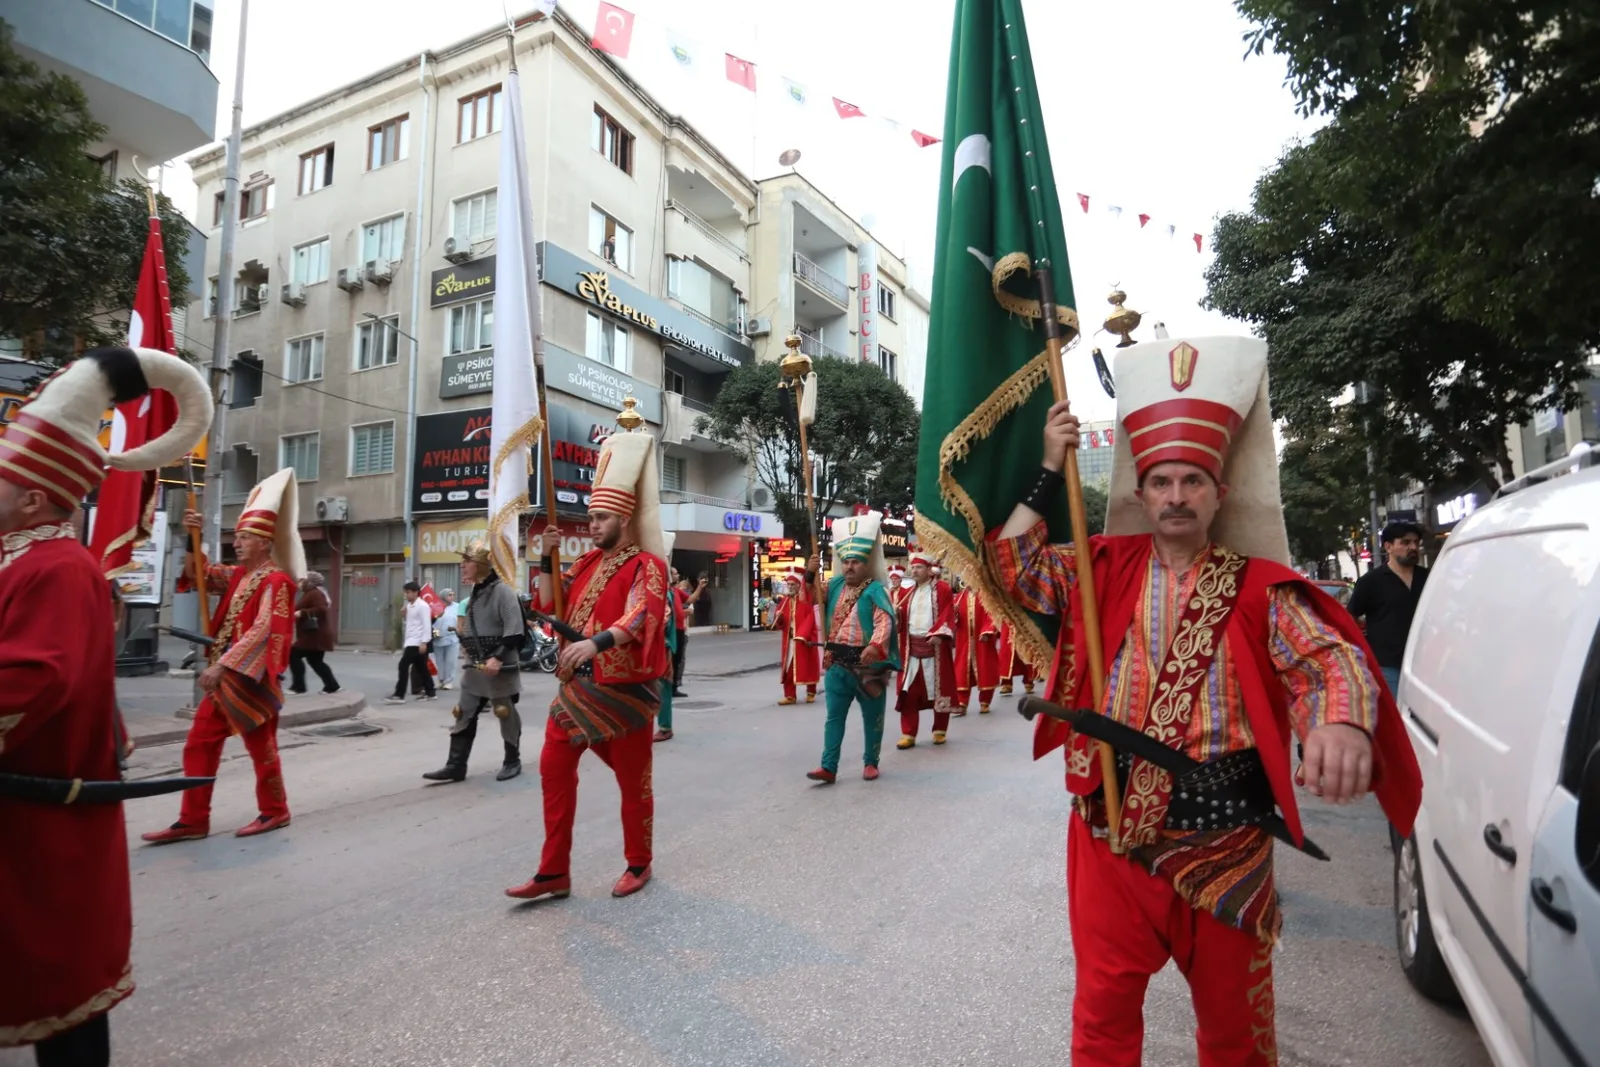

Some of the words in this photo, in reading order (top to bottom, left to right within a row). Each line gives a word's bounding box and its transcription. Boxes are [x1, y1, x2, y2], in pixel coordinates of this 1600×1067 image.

[447, 369, 493, 387] SÜMEYYE
[568, 372, 616, 400] SÜMEYYE
[588, 366, 634, 393] PSİKOLOG
[422, 447, 472, 468] AYHAN
[724, 511, 762, 533] arzu
